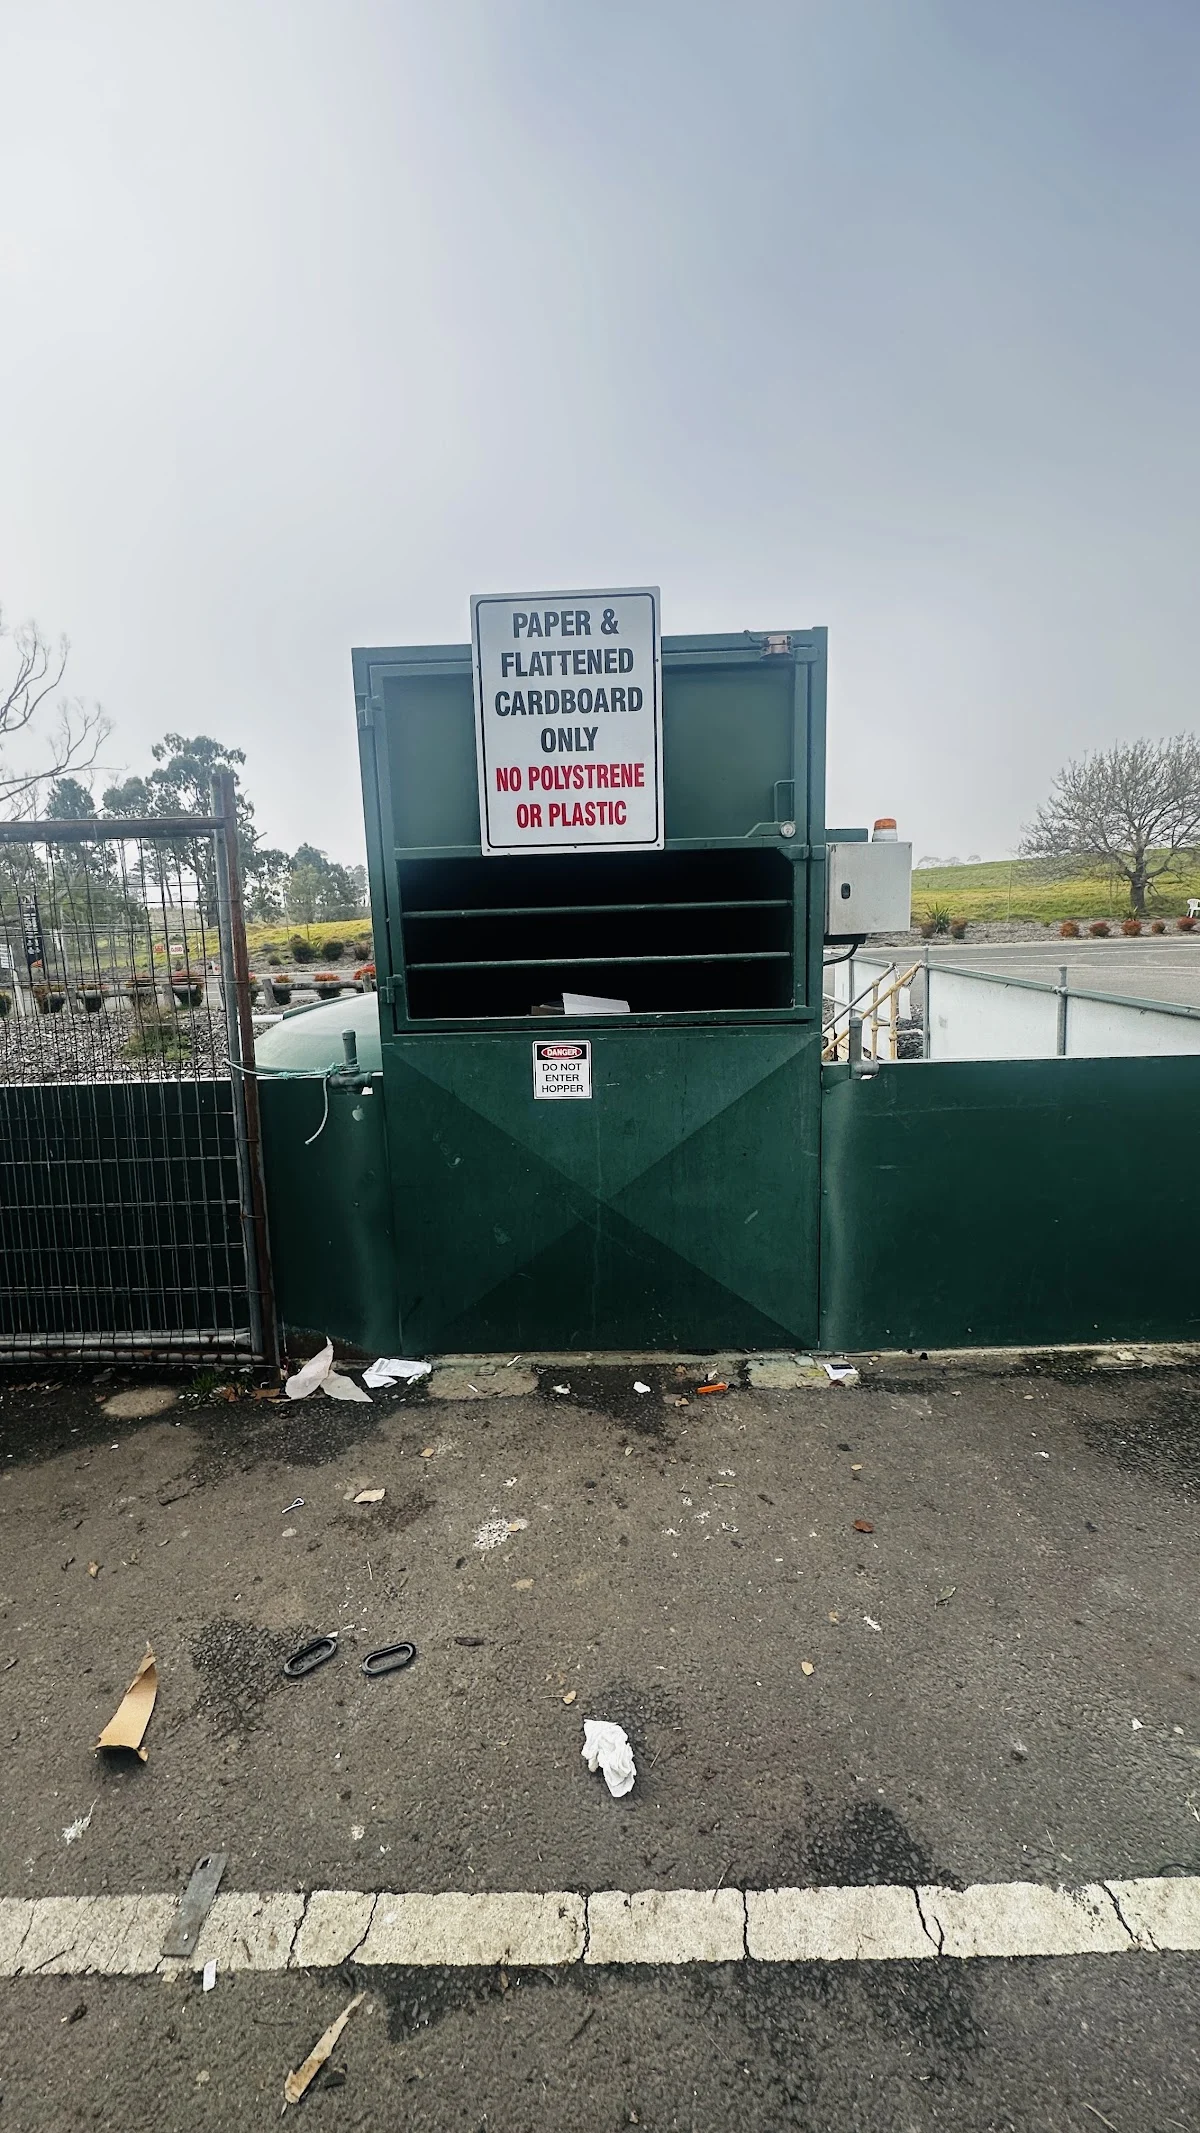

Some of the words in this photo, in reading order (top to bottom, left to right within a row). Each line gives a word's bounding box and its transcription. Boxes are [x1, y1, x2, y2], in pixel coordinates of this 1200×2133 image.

[512, 610, 592, 639] PAPER
[600, 608, 620, 635] &
[501, 648, 634, 678] FLATTENED
[494, 686, 644, 717] CARDBOARD
[540, 726, 599, 753] ONLY
[495, 766, 522, 792] NO
[528, 763, 645, 791] POLYSTRENE
[516, 803, 543, 829] OR
[548, 800, 627, 827] PLASTIC
